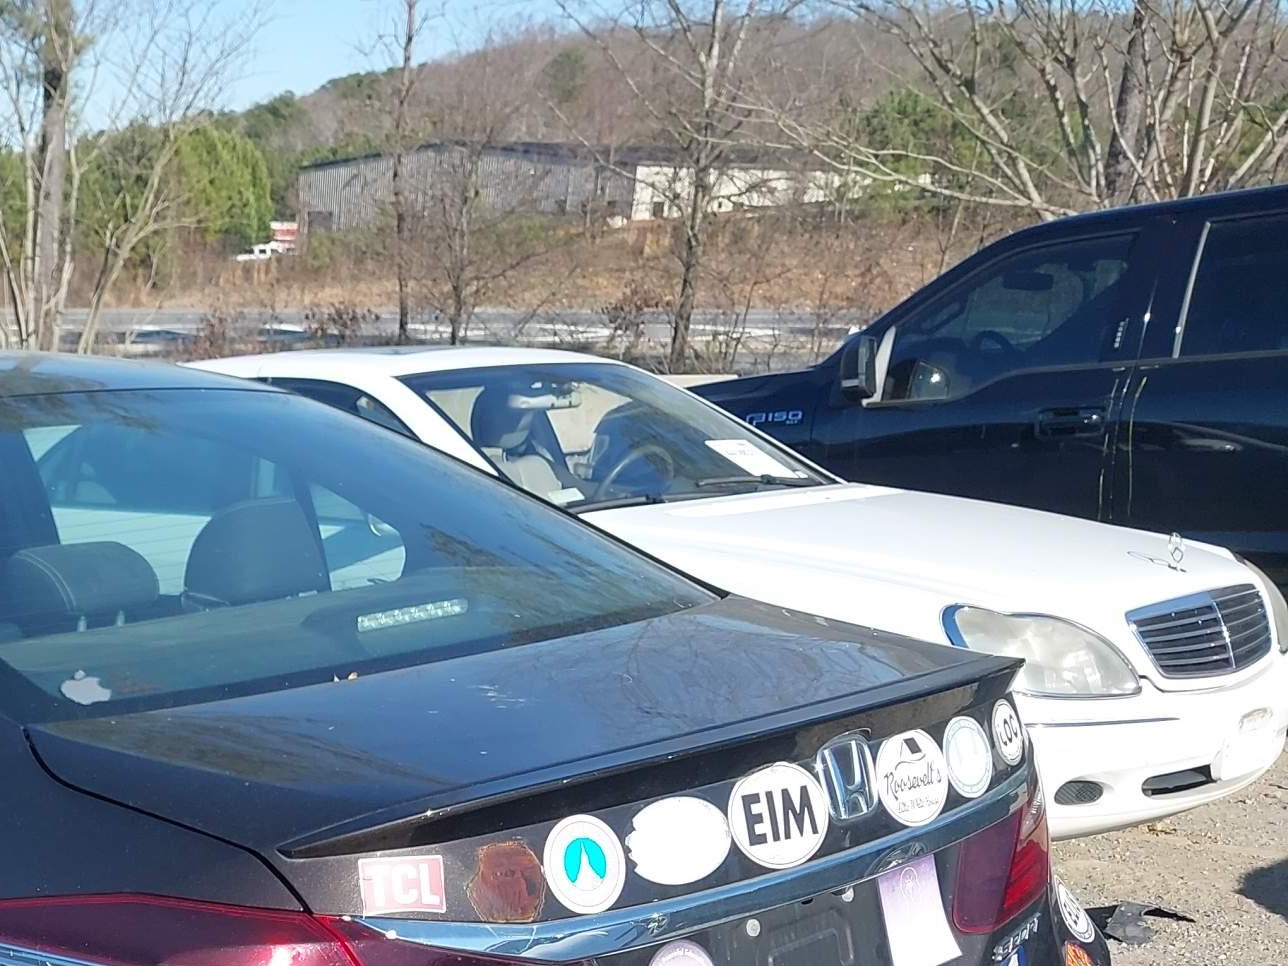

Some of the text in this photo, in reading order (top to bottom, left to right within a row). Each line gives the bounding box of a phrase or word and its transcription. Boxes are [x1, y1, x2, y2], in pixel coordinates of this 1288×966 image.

[884, 759, 942, 800] Roosevelt's
[740, 784, 820, 847] EIM
[364, 862, 441, 907] TCL
